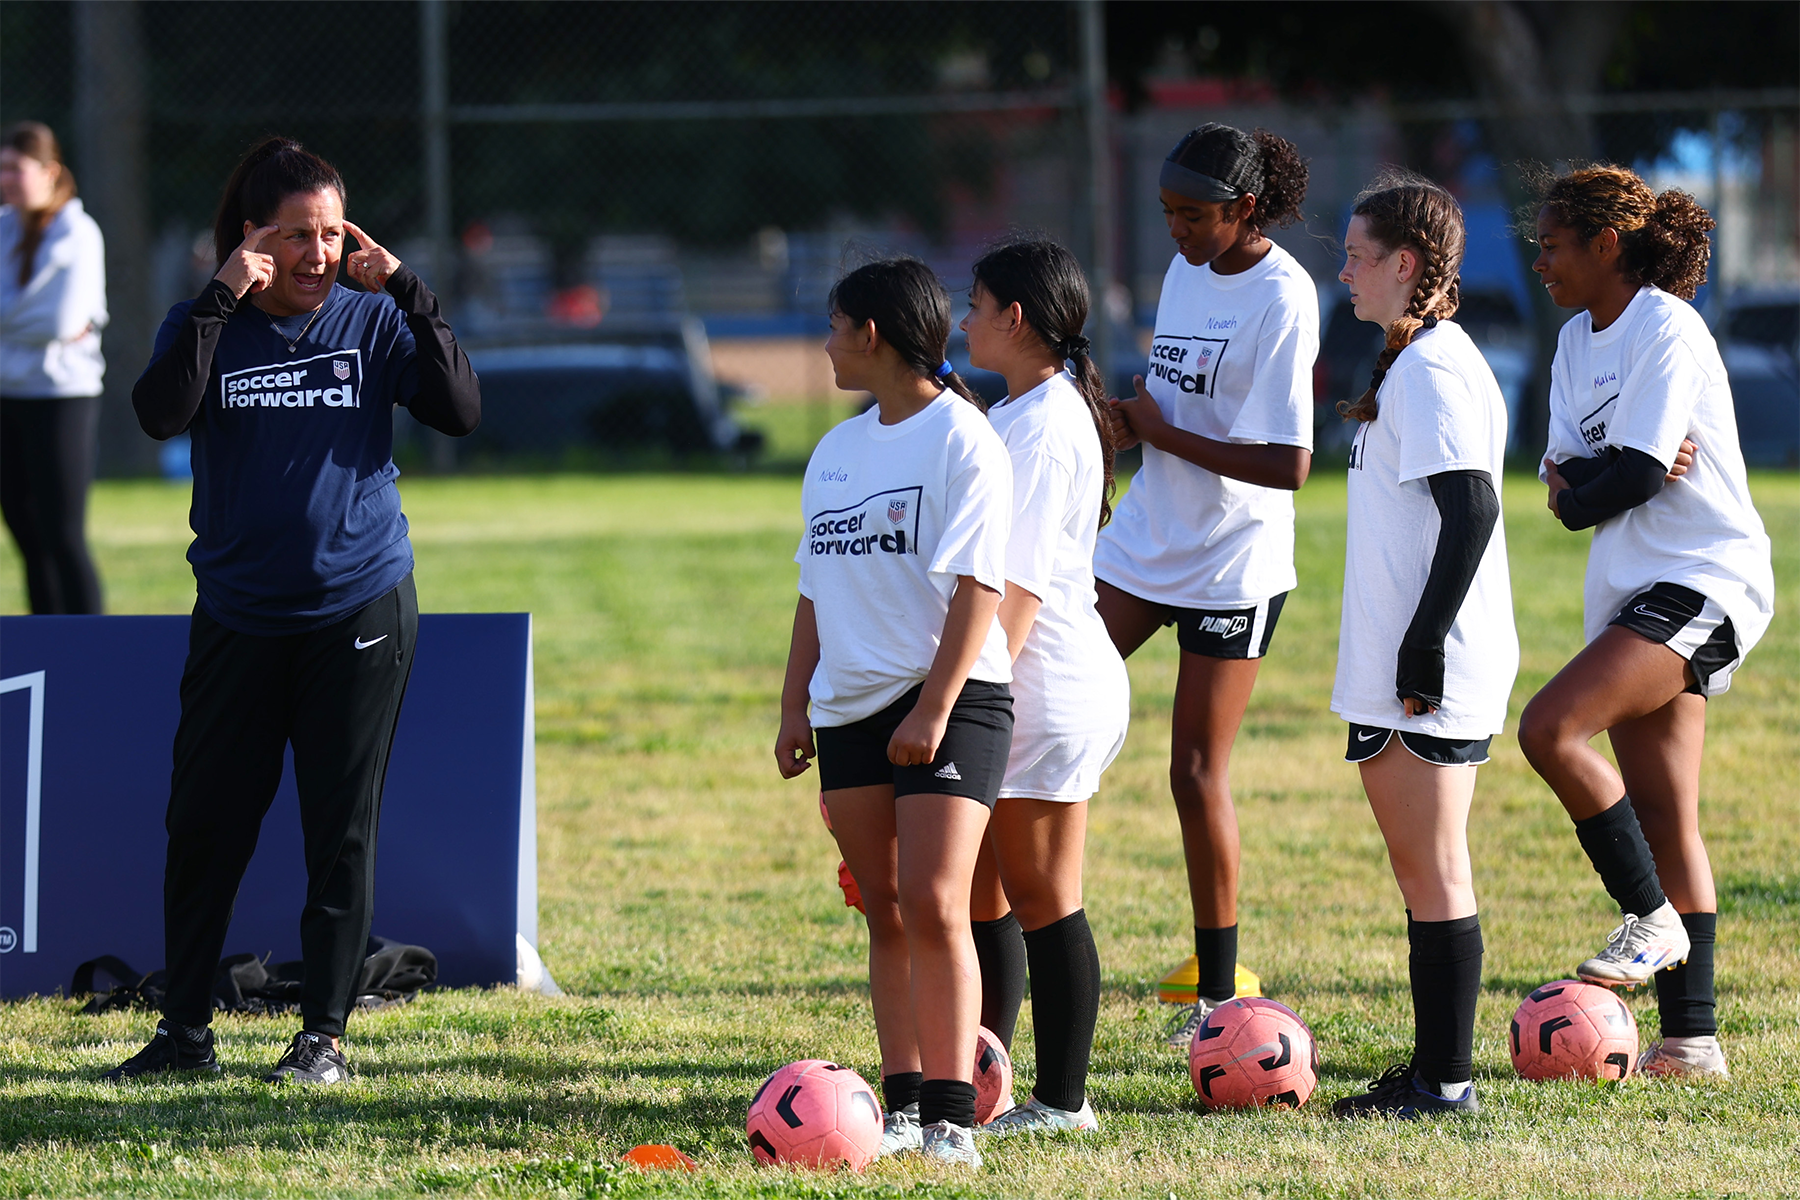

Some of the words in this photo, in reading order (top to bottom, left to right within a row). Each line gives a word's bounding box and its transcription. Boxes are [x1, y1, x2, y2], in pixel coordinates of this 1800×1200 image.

[1152, 344, 1189, 364] ccer
[334, 361, 349, 370] USA
[228, 369, 308, 394] soccer
[1593, 371, 1617, 389] Malia
[228, 384, 353, 408] forward
[818, 466, 848, 482] Noelia
[890, 501, 906, 511] USA
[811, 511, 867, 539] soccer
[810, 530, 906, 556] forward
